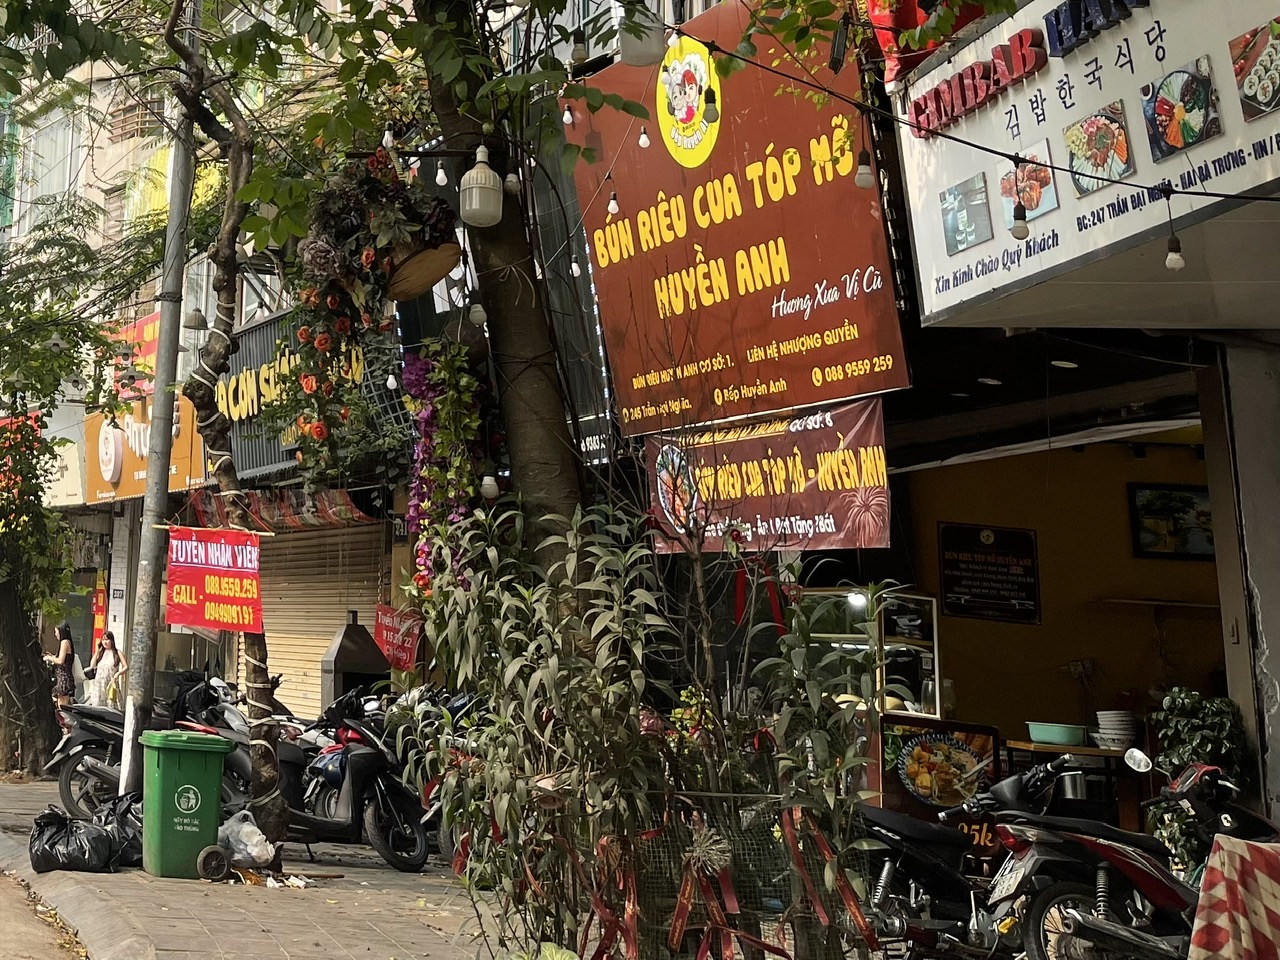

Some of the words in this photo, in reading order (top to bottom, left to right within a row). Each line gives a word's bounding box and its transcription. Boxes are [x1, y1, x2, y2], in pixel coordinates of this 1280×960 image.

[909, 28, 1048, 140] GIMBAB
[593, 213, 635, 269] BÚN
[636, 190, 687, 253] RIÊU
[692, 173, 743, 229] CUA
[745, 142, 802, 209] TÓP
[809, 113, 854, 186] MỠ
[1106, 194, 1129, 221] TRẦN
[1131, 189, 1146, 211] ĐẠI
[1180, 170, 1197, 190] HAI
[1198, 160, 1212, 182] BÀ
[1212, 149, 1247, 177] TRƯNG
[1252, 140, 1269, 160] HN
[653, 243, 730, 319] HUYỀN
[735, 236, 790, 296] ANH
[935, 275, 951, 294] Xin
[975, 255, 999, 278] Chào
[1001, 244, 1022, 272] Quý
[1025, 228, 1059, 259] Khách
[771, 289, 813, 320] Hương
[814, 279, 841, 309] Xưa
[841, 269, 861, 301] Vị
[862, 265, 883, 293] Cũ
[746, 344, 766, 363] LIÊN
[766, 340, 779, 361] HỆ
[779, 332, 822, 358] NHƯỢNG
[823, 319, 859, 346] QUYỀN
[632, 373, 646, 390] BÚN
[660, 367, 683, 383] HUYN
[683, 362, 699, 378] ANH
[699, 360, 711, 374] CƠ
[741, 379, 768, 399] Huyền
[769, 378, 788, 394] Anh
[824, 365, 844, 383] 088
[845, 360, 871, 379] 9559
[872, 355, 893, 373] 259
[816, 432, 859, 491] HUYỀN
[859, 445, 887, 488] ANH
[171, 532, 205, 564] TUYỂN
[208, 538, 233, 567] NHÂN
[234, 541, 258, 569] VIÊN
[173, 584, 197, 604] CALL
